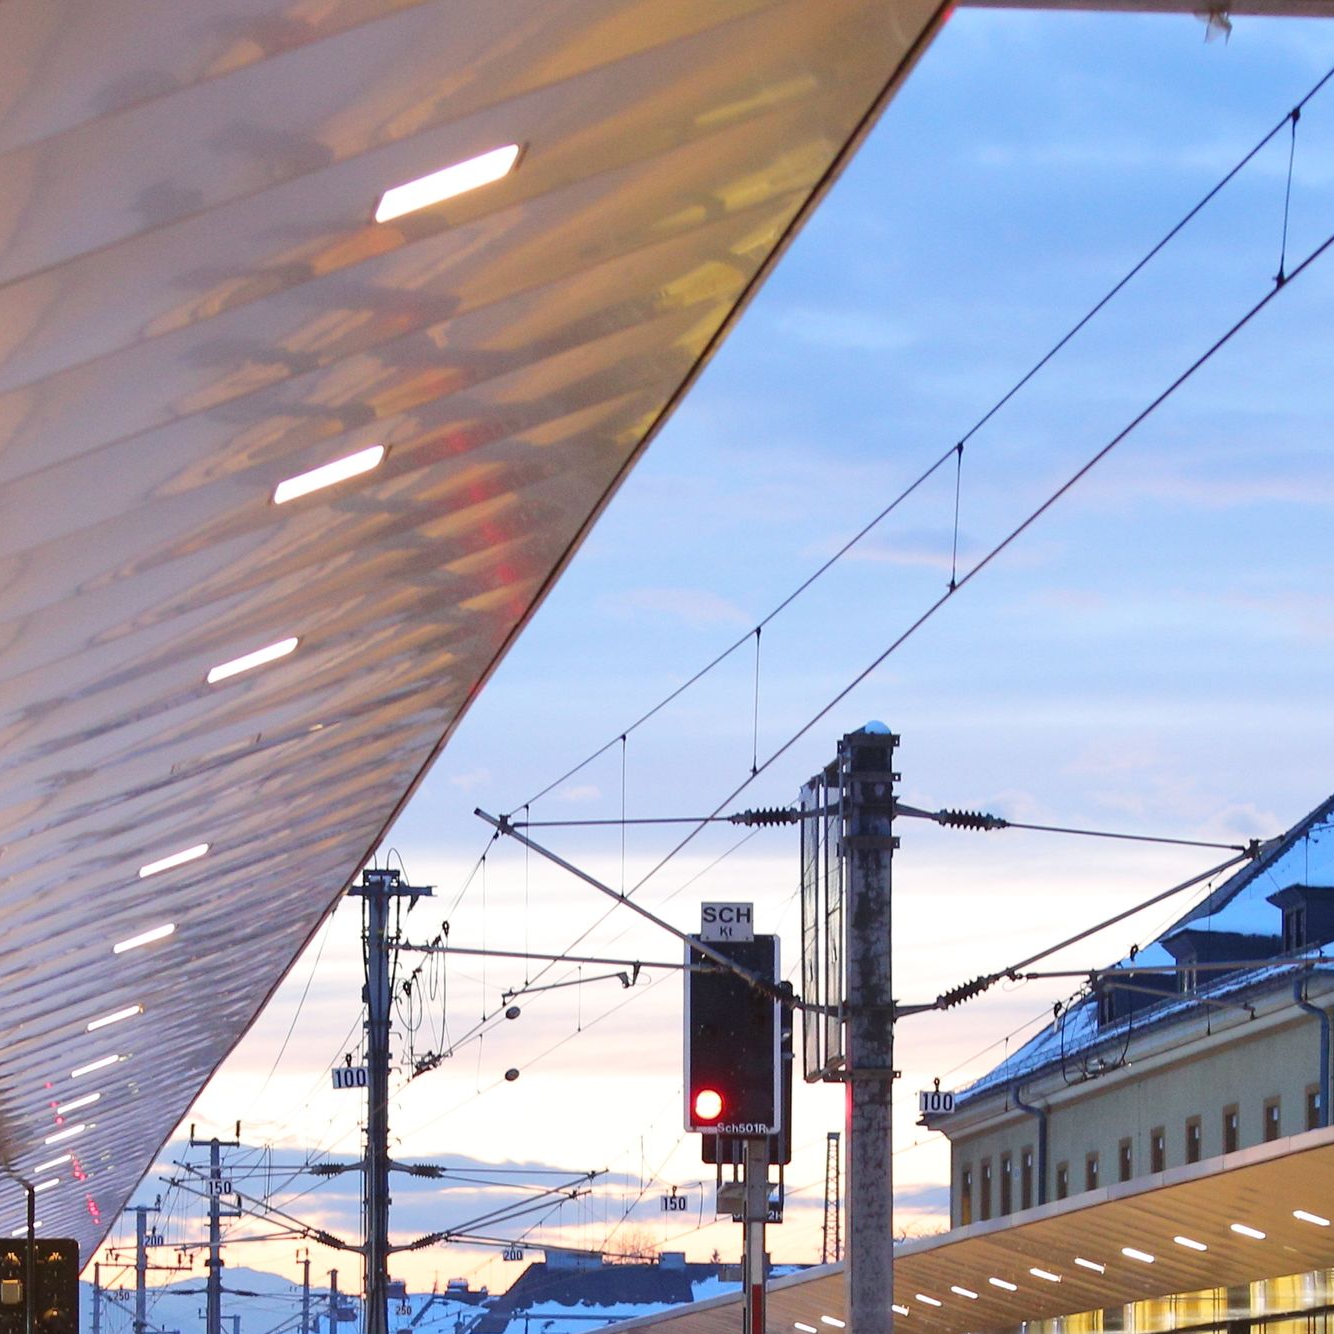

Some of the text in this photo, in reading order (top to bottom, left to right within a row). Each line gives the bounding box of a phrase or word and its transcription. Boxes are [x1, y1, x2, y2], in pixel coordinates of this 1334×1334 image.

[703, 906, 751, 923] SCH
[335, 1069, 365, 1088] 100
[923, 1092, 952, 1111] 100
[209, 1181, 231, 1195] 150
[664, 1196, 686, 1211] 150
[145, 1235, 163, 1247] 200
[503, 1249, 523, 1261] 200
[396, 1305, 412, 1315] 250
